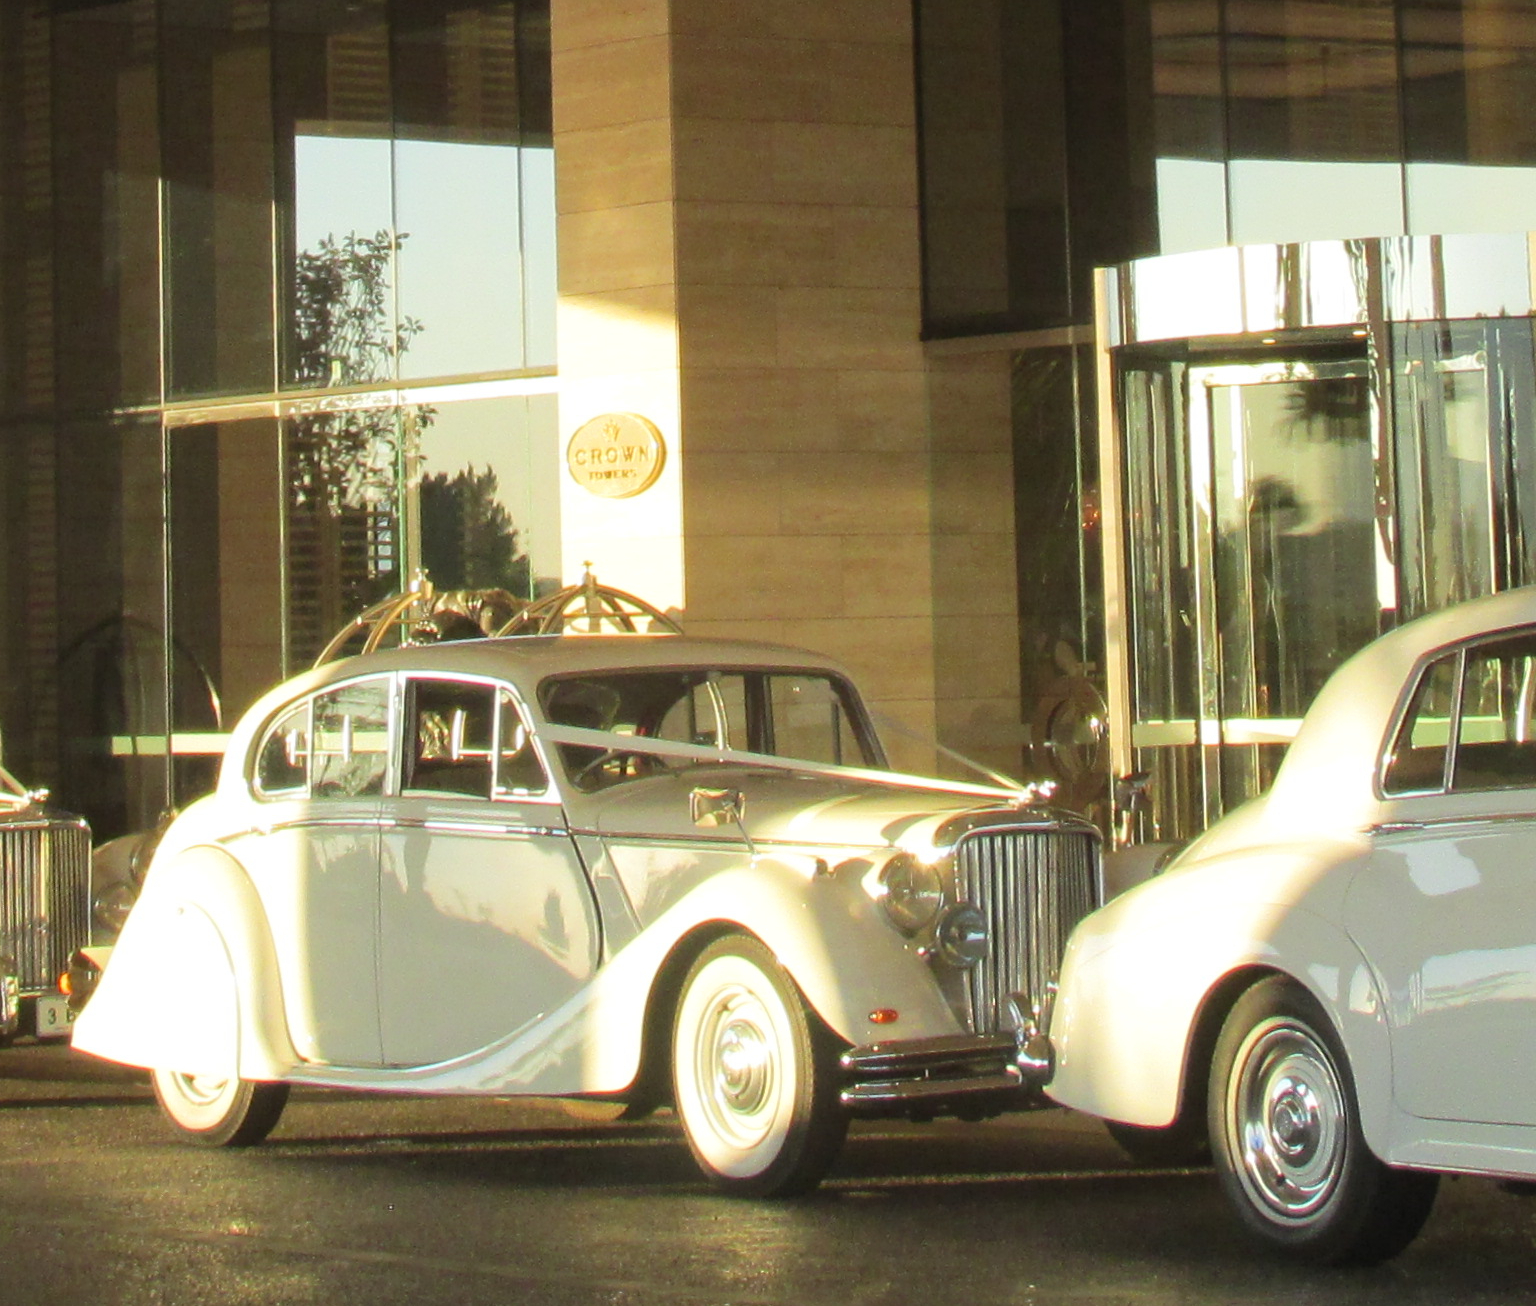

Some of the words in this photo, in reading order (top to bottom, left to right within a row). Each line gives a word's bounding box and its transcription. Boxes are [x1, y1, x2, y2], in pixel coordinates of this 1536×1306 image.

[575, 445, 649, 465] CROWN
[589, 469, 637, 480] TOWERS
[48, 1007, 57, 1025] 3
